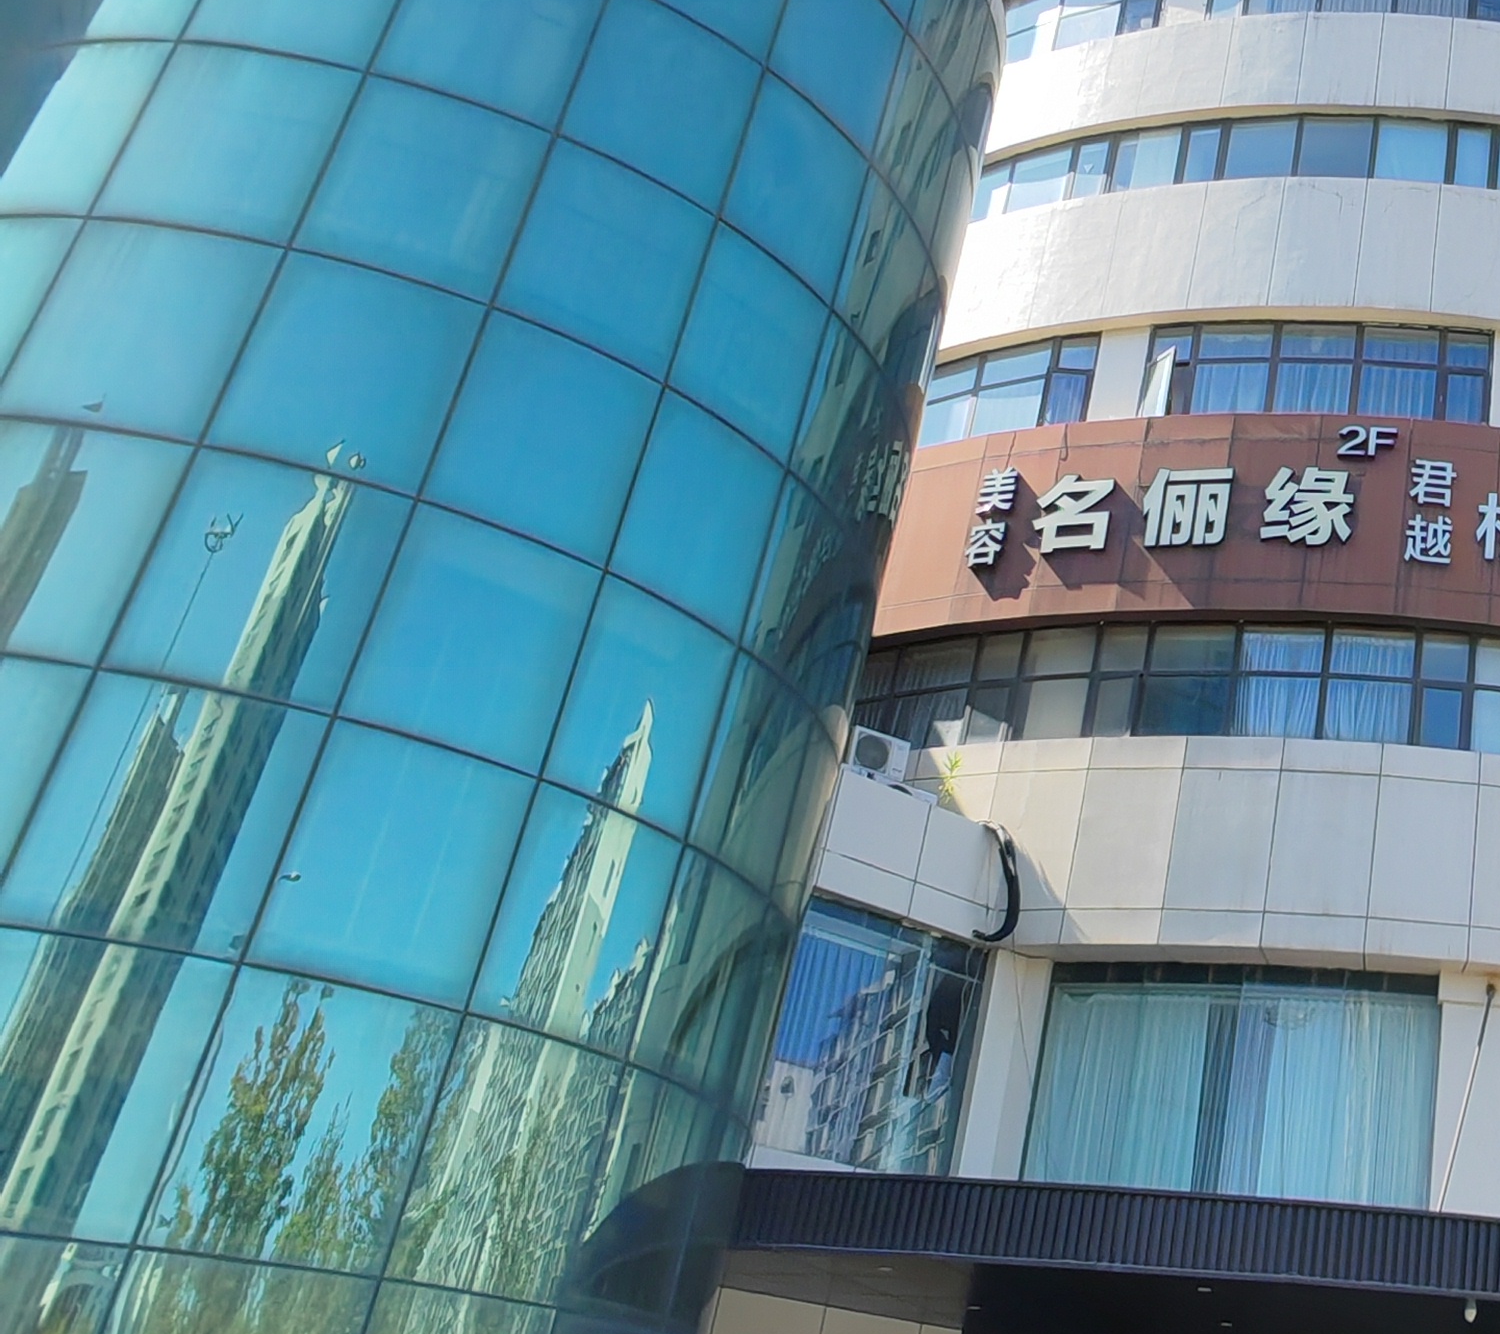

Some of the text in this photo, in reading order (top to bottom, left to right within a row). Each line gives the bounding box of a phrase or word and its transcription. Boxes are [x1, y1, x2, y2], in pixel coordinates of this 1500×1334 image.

[1336, 424, 1399, 459] 2F
[966, 466, 1019, 568] 美容
[1032, 465, 1355, 555] 名俪缘
[1404, 457, 1458, 566] 君越
